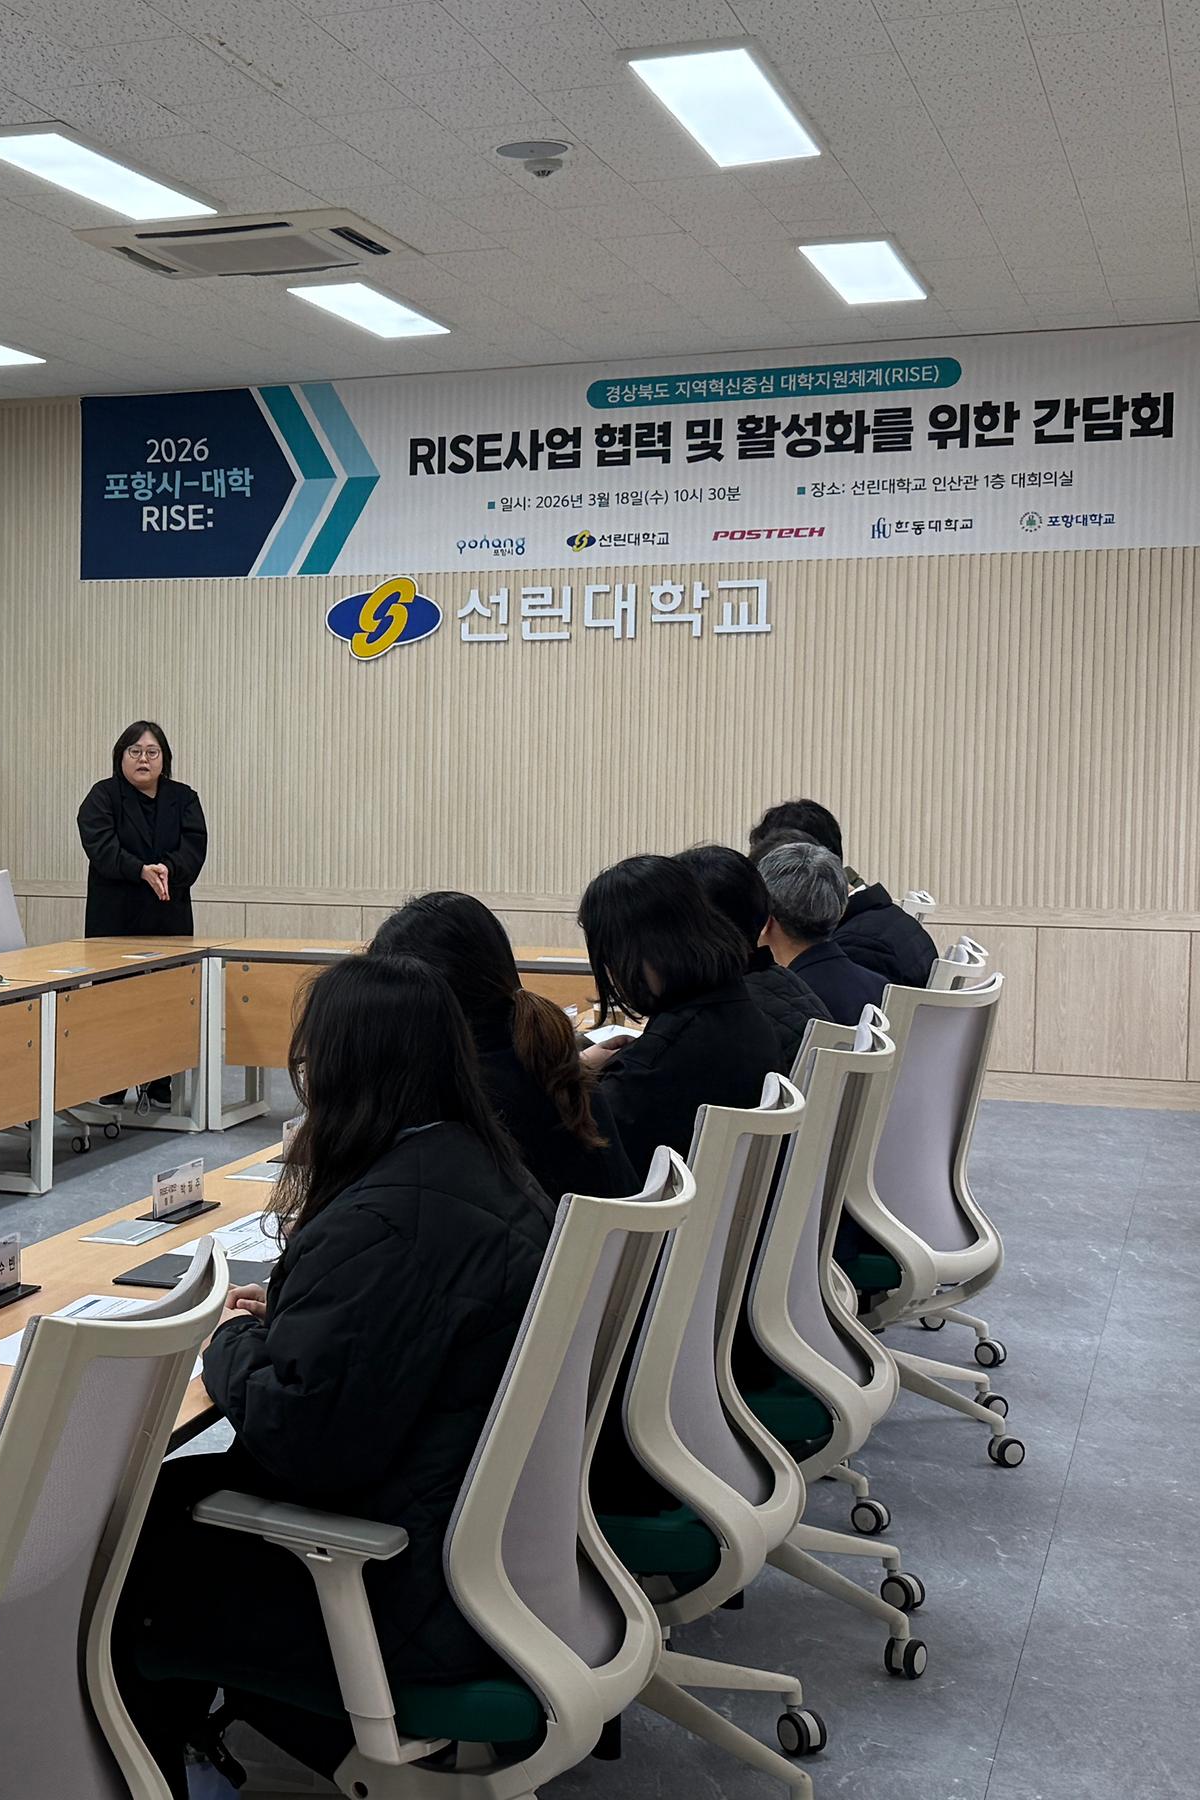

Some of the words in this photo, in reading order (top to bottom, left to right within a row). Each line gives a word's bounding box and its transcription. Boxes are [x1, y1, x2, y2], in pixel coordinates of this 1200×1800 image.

[606, 382, 669, 404] 경상북도
[675, 375, 775, 399] 지역혁신중심
[781, 365, 941, 392] 대학지원체계(RISE)
[409, 426, 582, 476] RISE사업
[594, 421, 671, 468] 협력
[686, 418, 724, 464] 및
[736, 406, 914, 461] 활성화를
[928, 400, 1020, 450] 위한
[1033, 391, 1175, 445] 간담회
[146, 438, 209, 463] 2026
[104, 467, 254, 501] 포항시-대학
[811, 481, 846, 498] 장소:
[850, 476, 927, 496] 선린대학교
[932, 474, 979, 492] 인산관
[984, 473, 1006, 490] 1층
[1011, 470, 1074, 489] 대회의실
[500, 496, 531, 512] 일시:
[535, 493, 583, 510] 2026년
[588, 491, 610, 508] 3월
[615, 489, 669, 507] 18일(수)
[673, 487, 703, 504] 10시
[708, 485, 742, 502] 30분
[142, 504, 214, 532] RISE:
[895, 518, 973, 536] 한동대학교
[1047, 512, 1117, 529] 포항대학교
[599, 531, 670, 548] 선린대학교
[712, 526, 826, 541] POSTECH
[457, 578, 772, 642] 선린대학교
